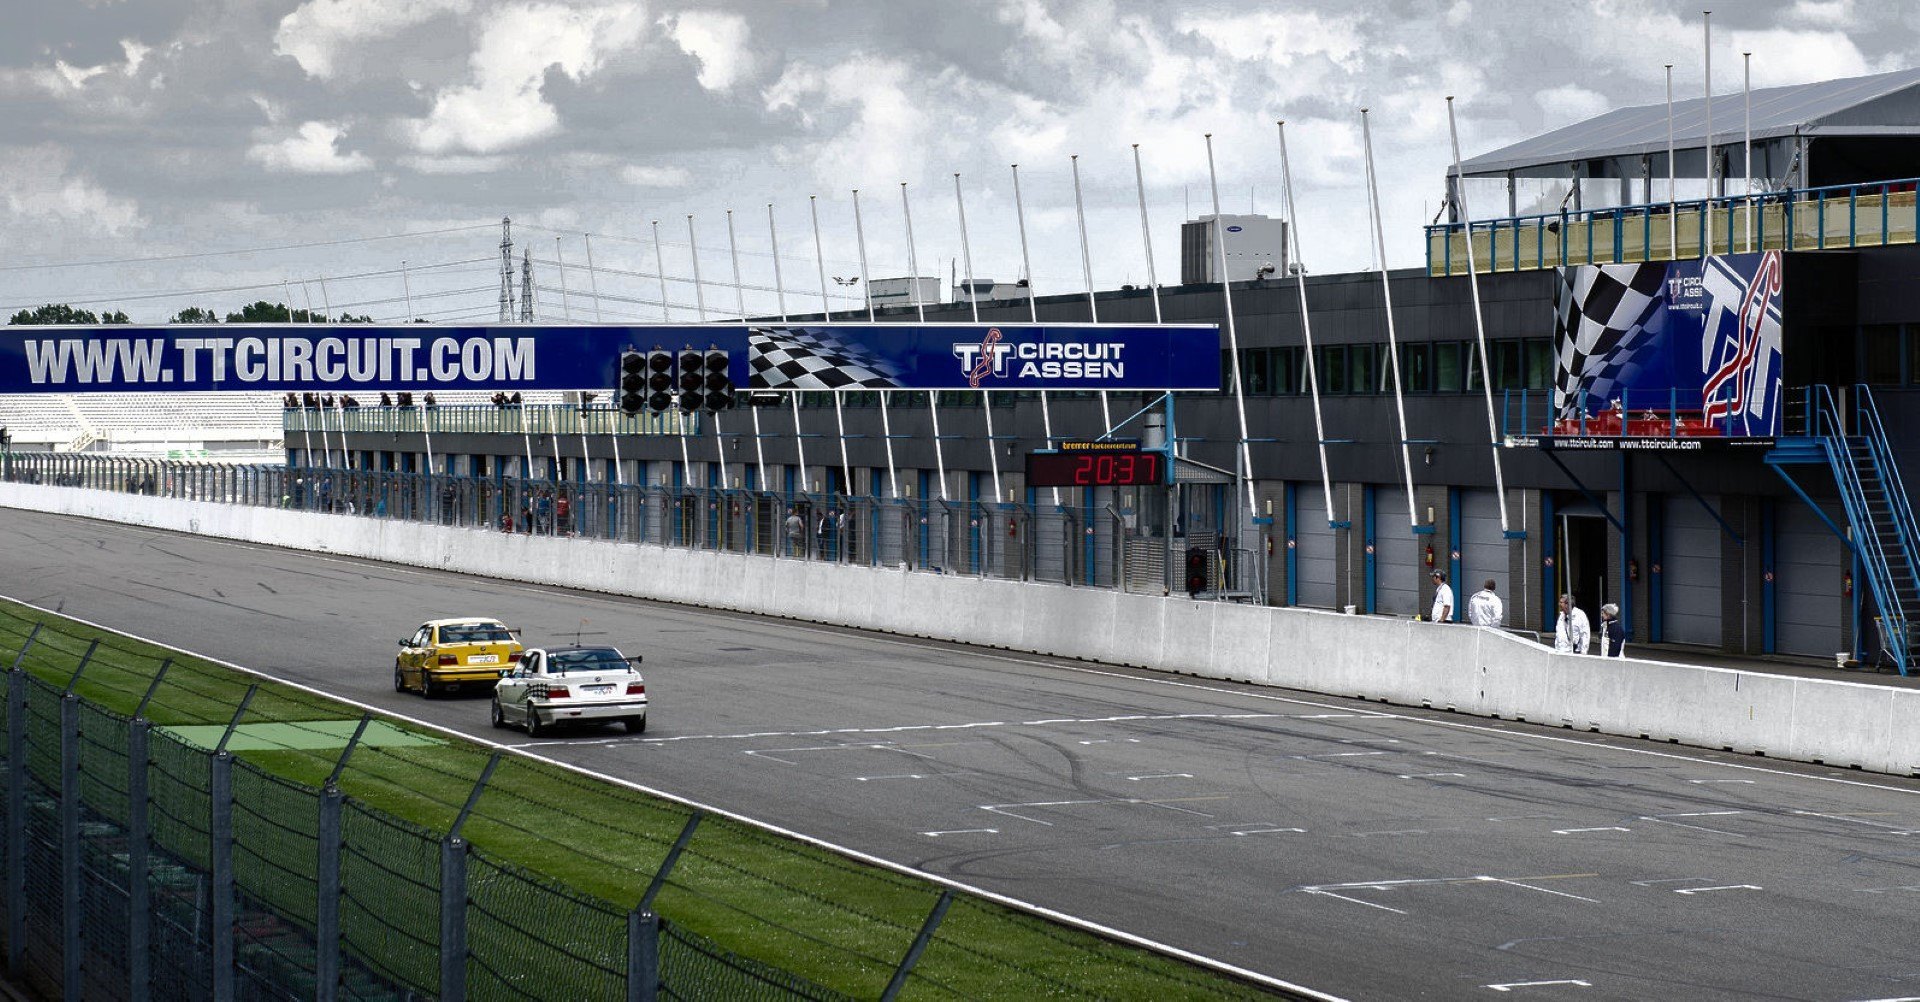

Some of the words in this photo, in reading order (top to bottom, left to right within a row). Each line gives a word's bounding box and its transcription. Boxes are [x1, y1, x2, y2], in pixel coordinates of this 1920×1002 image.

[25, 337, 535, 384] WWW.TTCIRCUIT.COM
[953, 342, 1017, 378] TT
[1018, 342, 1125, 360] CIRCUIT
[1018, 361, 1125, 379] ASSEN
[1619, 438, 1701, 450] www.ttcircuit.com
[1075, 455, 1156, 484] 20:37
